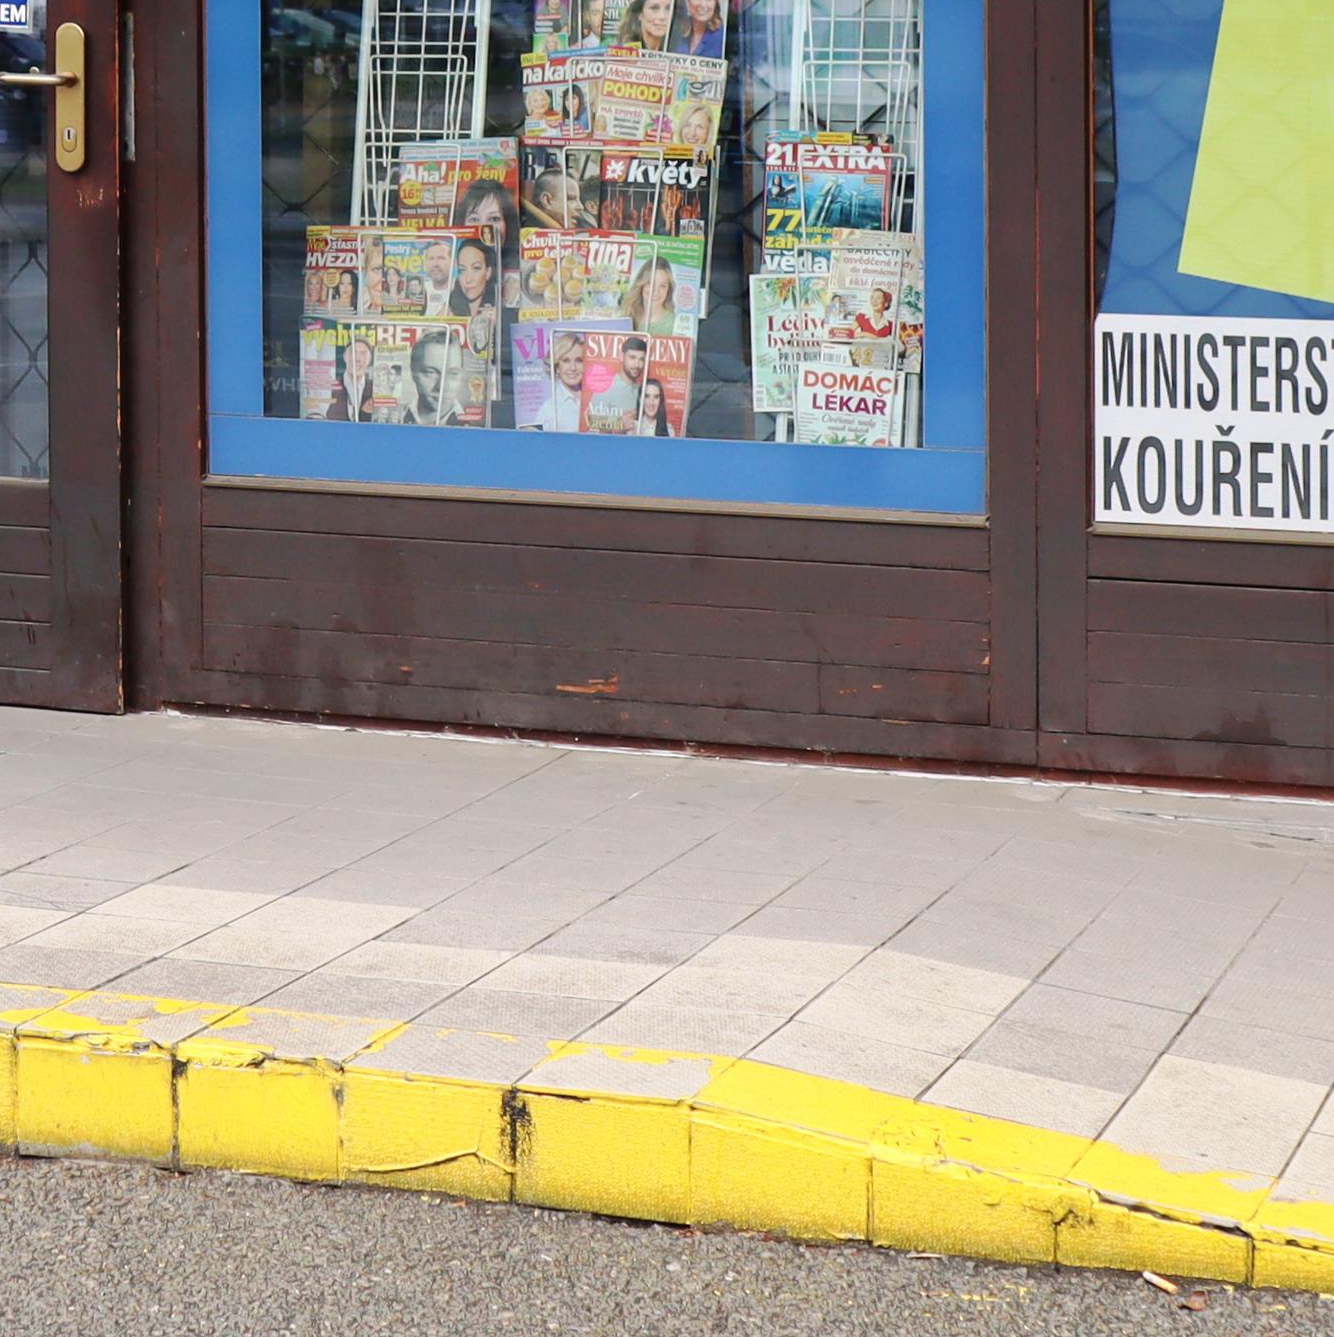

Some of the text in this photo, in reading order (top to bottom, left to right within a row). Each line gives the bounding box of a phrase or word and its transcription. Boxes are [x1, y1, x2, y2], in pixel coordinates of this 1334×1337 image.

[797, 144, 887, 170] EXTRA
[627, 157, 703, 189] květy
[766, 209, 803, 232] 77
[803, 370, 901, 397] DOMÁCÍ
[812, 389, 889, 416] LÉKAŘ
[1101, 424, 1332, 523] KOUŘENÍ
